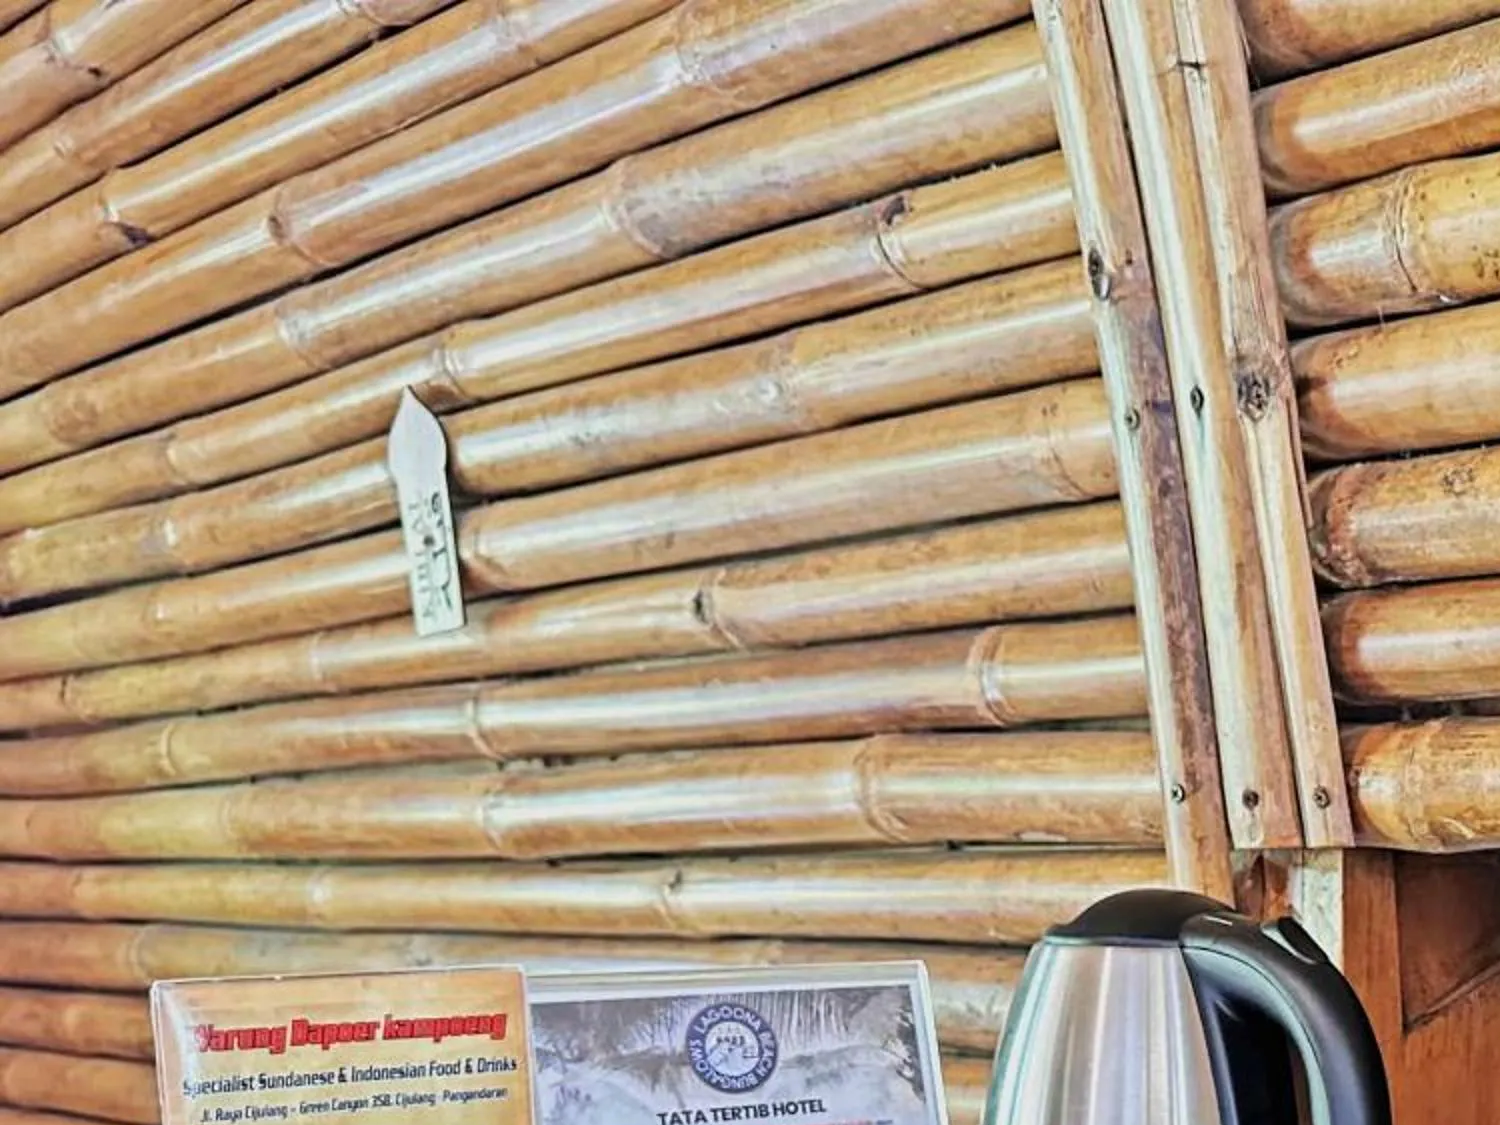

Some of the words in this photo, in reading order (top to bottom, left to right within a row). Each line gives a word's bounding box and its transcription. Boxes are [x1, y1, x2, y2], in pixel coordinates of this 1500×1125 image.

[291, 1018, 380, 1050] Dapoer
[383, 1012, 507, 1042] kampoeng
[693, 1005, 761, 1034] LAGOONA
[183, 1075, 256, 1099] Specialist
[258, 1068, 335, 1090] Sundanese
[338, 1066, 347, 1083] &
[351, 1063, 426, 1083] Indonesian
[429, 1060, 461, 1078] Food
[464, 1058, 473, 1075] &
[477, 1056, 518, 1074] Drinks
[216, 1106, 242, 1123] Raya
[245, 1104, 288, 1121] Cijulang
[299, 1100, 330, 1115] Green
[332, 1098, 368, 1113] Canyon
[442, 1087, 509, 1104] Pangandaran
[710, 1103, 770, 1124] TERTIB
[773, 1097, 827, 1118] HOTEL
